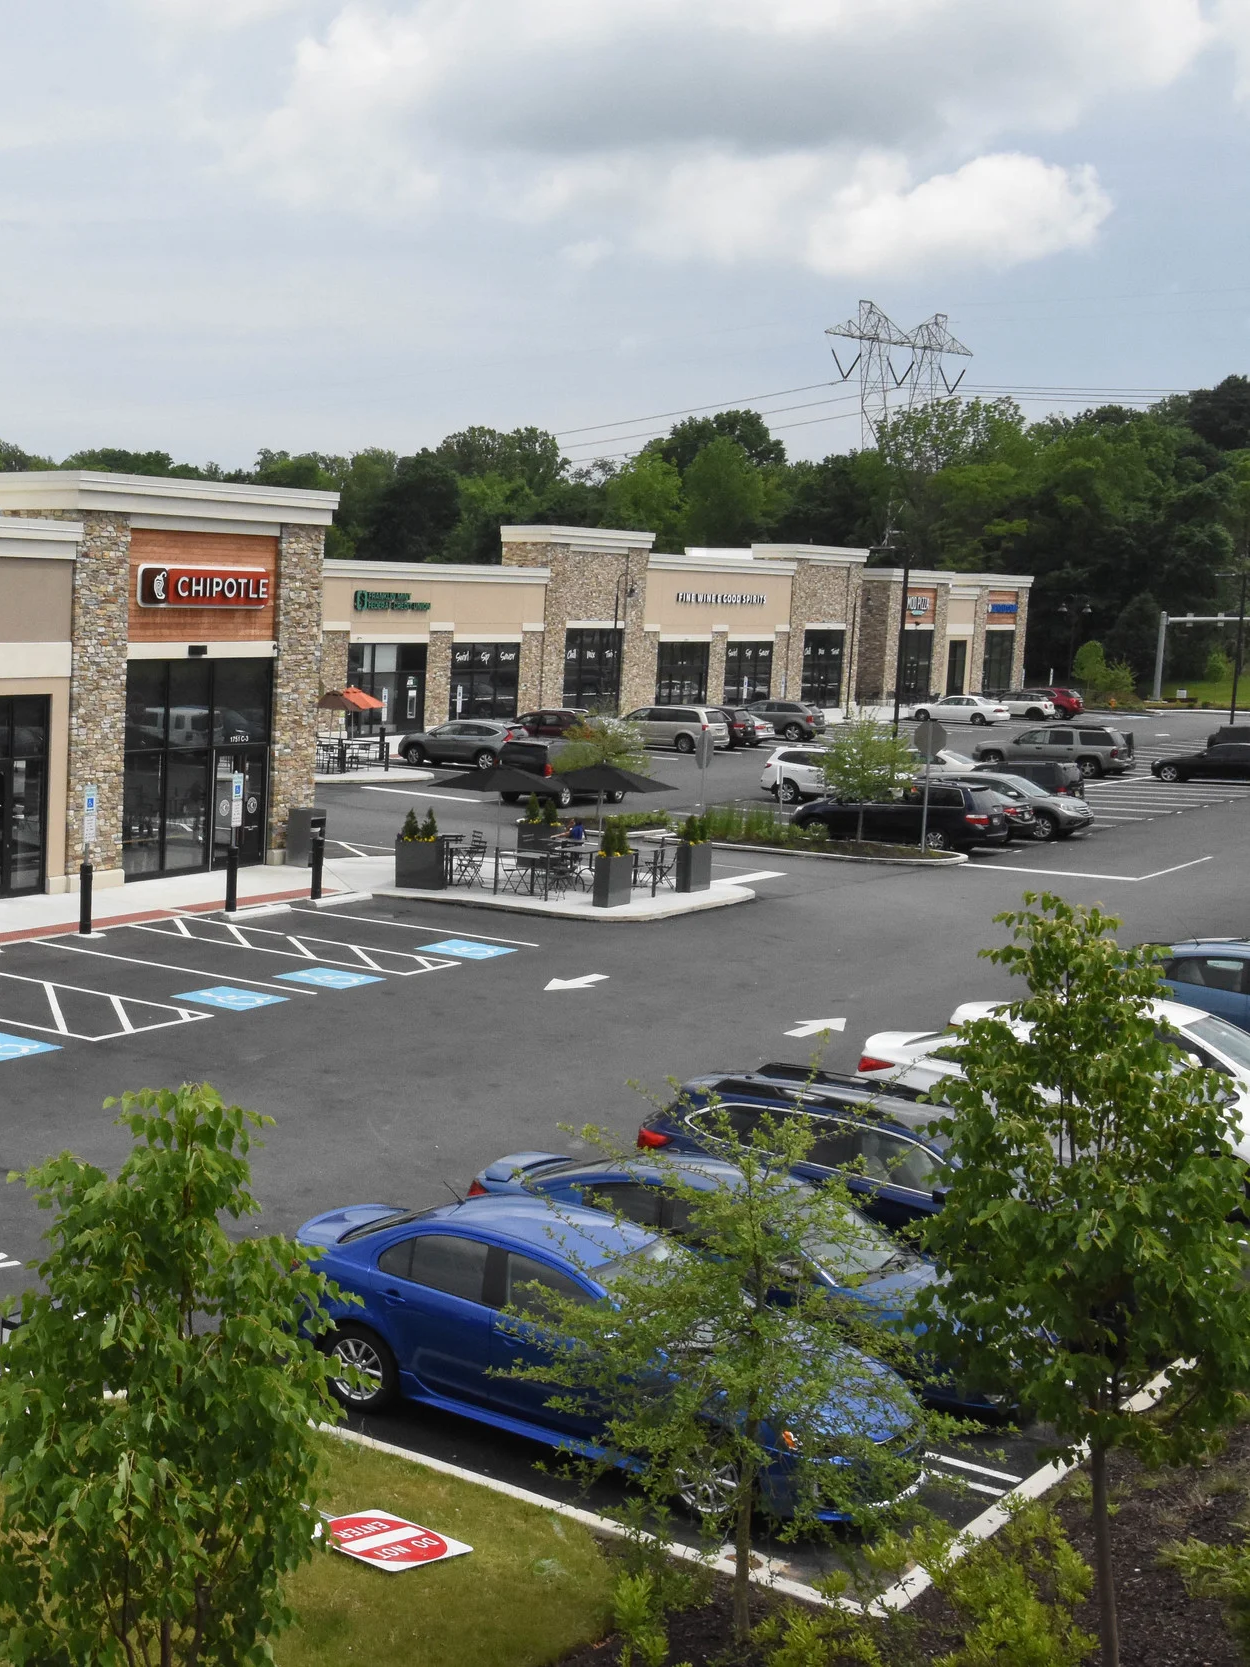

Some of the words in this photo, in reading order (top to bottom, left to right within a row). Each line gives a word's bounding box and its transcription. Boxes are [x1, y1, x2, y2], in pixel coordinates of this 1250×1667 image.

[177, 576, 269, 599] CHIPOTLE
[678, 593, 695, 602] FINE
[697, 593, 716, 603] WINE
[723, 594, 741, 604] GOOD
[742, 594, 767, 605] SPIRITS
[334, 1521, 391, 1539] ENTER
[410, 1537, 440, 1549] DO
[373, 1544, 411, 1559] NOT
